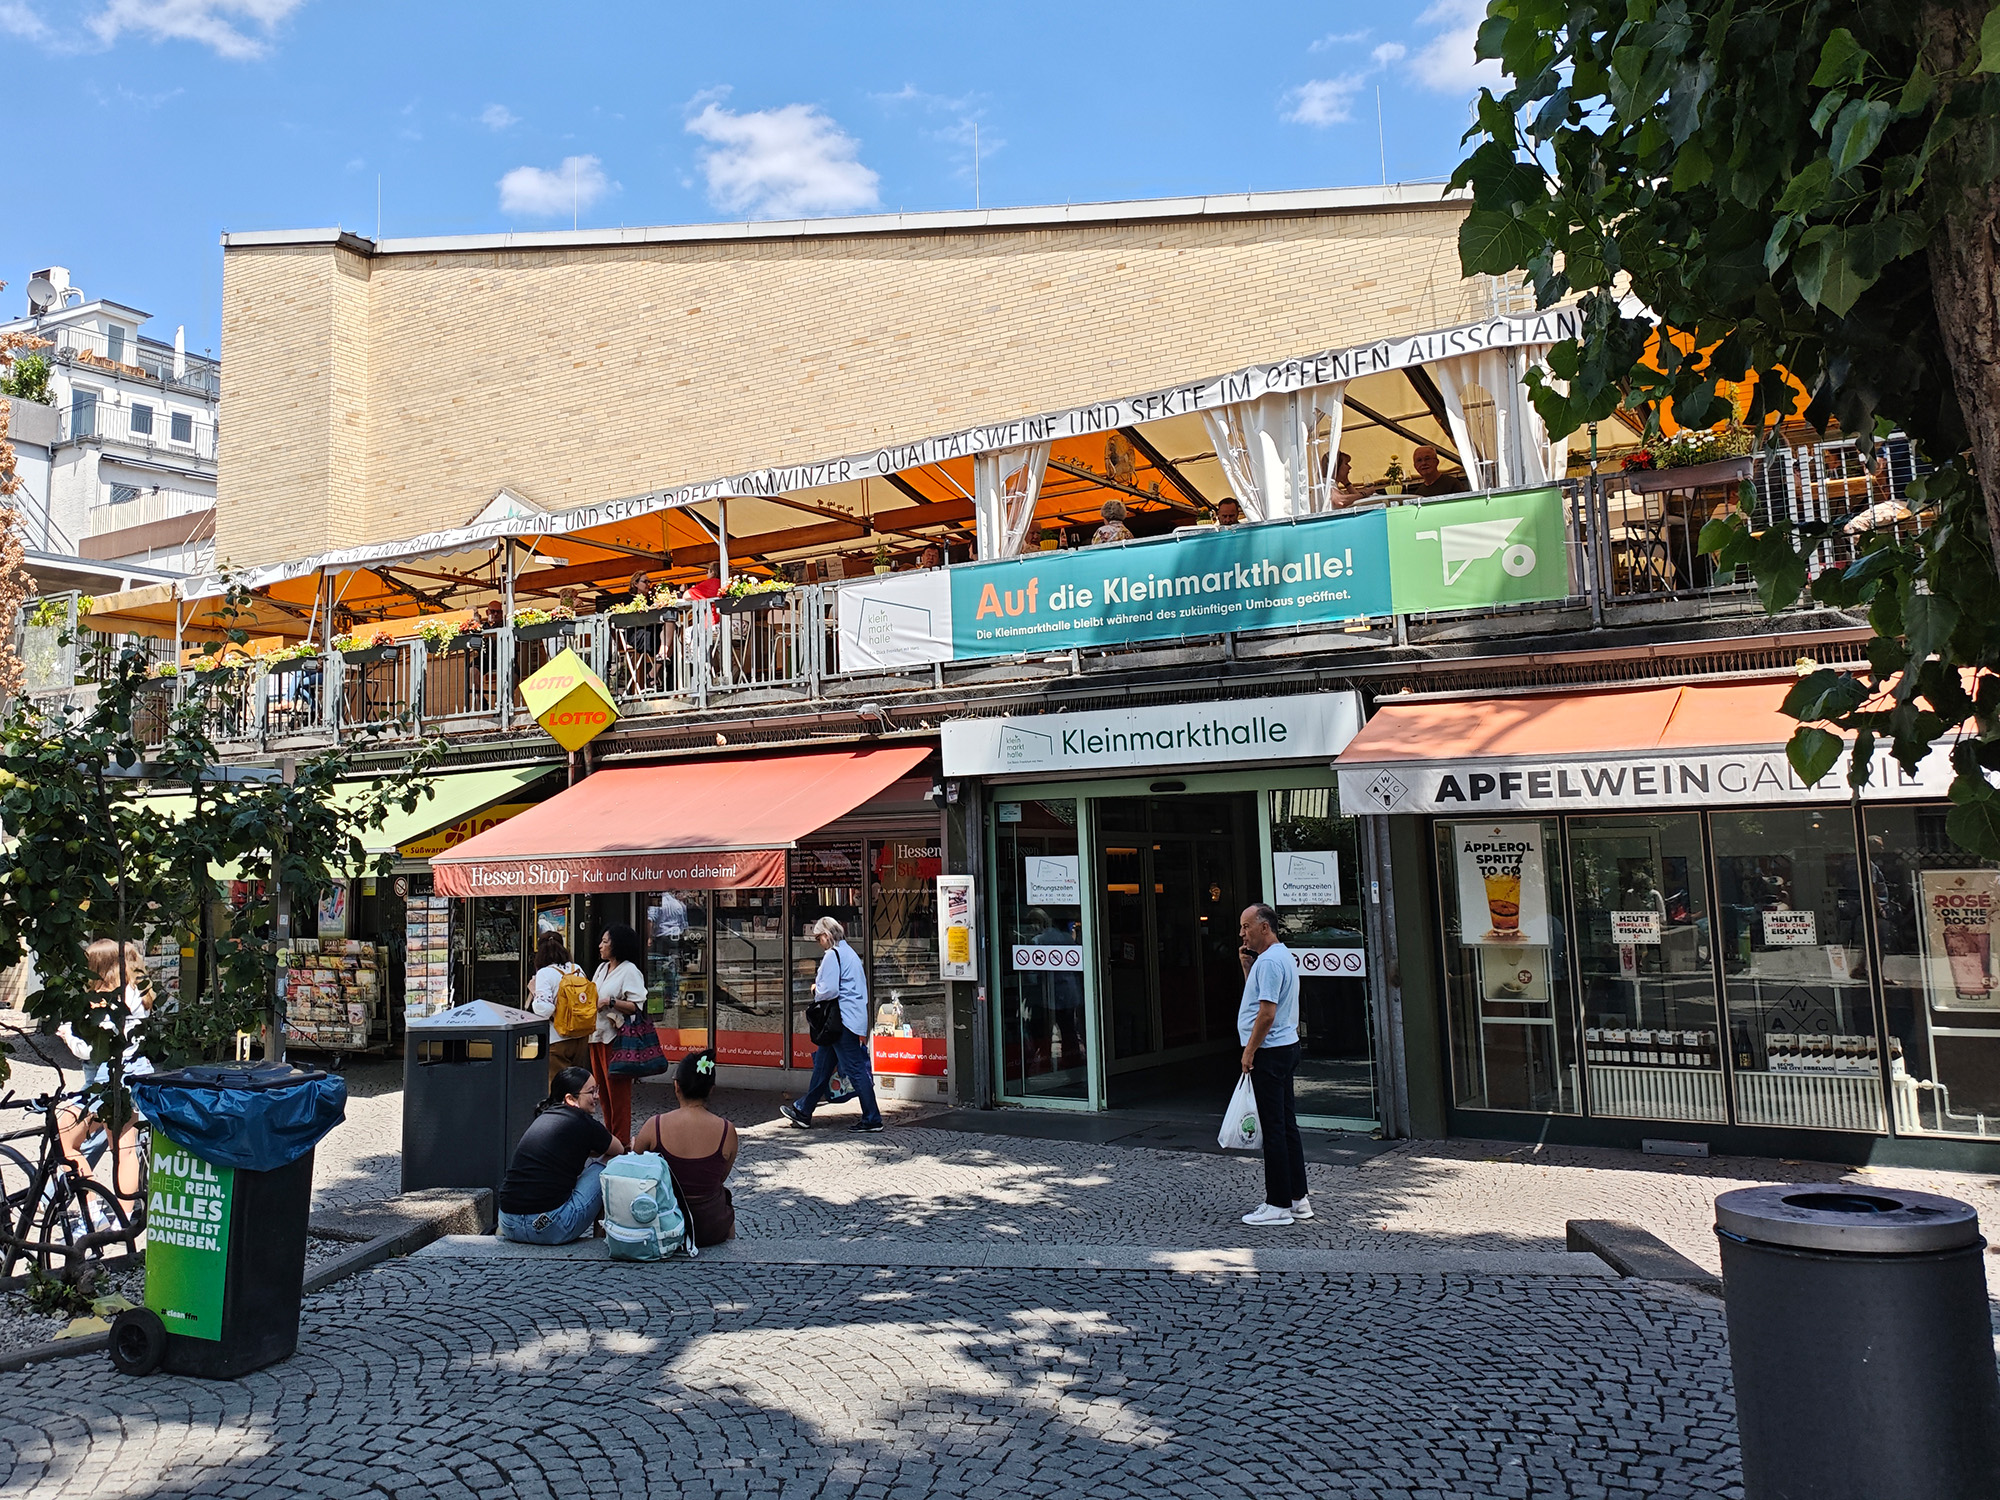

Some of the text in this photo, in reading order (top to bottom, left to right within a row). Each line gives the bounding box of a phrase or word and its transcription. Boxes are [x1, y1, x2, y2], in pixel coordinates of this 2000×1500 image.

[507, 514, 558, 532] WEINE
[566, 508, 598, 531] UND
[605, 496, 655, 520] SEKTE
[663, 481, 723, 506] DIREKT
[877, 416, 1056, 474] QUALITÄTSWEINE
[1070, 404, 1120, 434] UND
[1132, 384, 1206, 422] SEKTE
[1220, 373, 1251, 403] IM
[1265, 344, 1390, 388] OFFENEN
[976, 548, 1353, 620] Auf die Kleinmarkthalle!
[868, 610, 888, 624] klein
[976, 589, 1351, 640] Die Kleinmarkthalle bleibt während des zukünftigen Umbaus geöffnet.
[868, 623, 894, 634] markt
[868, 635, 891, 645] halle
[527, 675, 575, 691] LOTTO
[548, 711, 607, 726] LOTTO
[1062, 716, 1288, 755] Kleinmarkthalle
[897, 844, 942, 859] Hessen
[1463, 840, 1535, 853] ÄPPLEROL
[1475, 854, 1523, 864] SPRITZ
[471, 866, 527, 887] Hessen
[528, 864, 570, 891] Shop
[582, 869, 603, 883] Kult
[606, 867, 627, 882] und
[630, 867, 663, 881] Kultur
[667, 869, 687, 879] von
[690, 864, 736, 878] daheim!
[1479, 866, 1521, 876] TO GO
[1032, 884, 1074, 892] Öffnungszeiten
[1282, 882, 1332, 891] Öffnungszeiten
[1934, 890, 1992, 908] ROSÉ
[1771, 915, 1806, 923] HEUTE
[1941, 908, 1987, 917] ON THE
[1944, 916, 1987, 926] ROCKS
[1789, 999, 1807, 1012] W
[1771, 1017, 1786, 1030] A
[737, 1047, 752, 1055] Kultur
[153, 1150, 219, 1182] MÜLL
[151, 1177, 226, 1199] HIER REIN.
[149, 1191, 223, 1222] ALLES
[148, 1215, 221, 1235] ANDERE IST
[147, 1227, 221, 1252] DANEBEN.
[160, 1307, 198, 1321] #cleanffm
